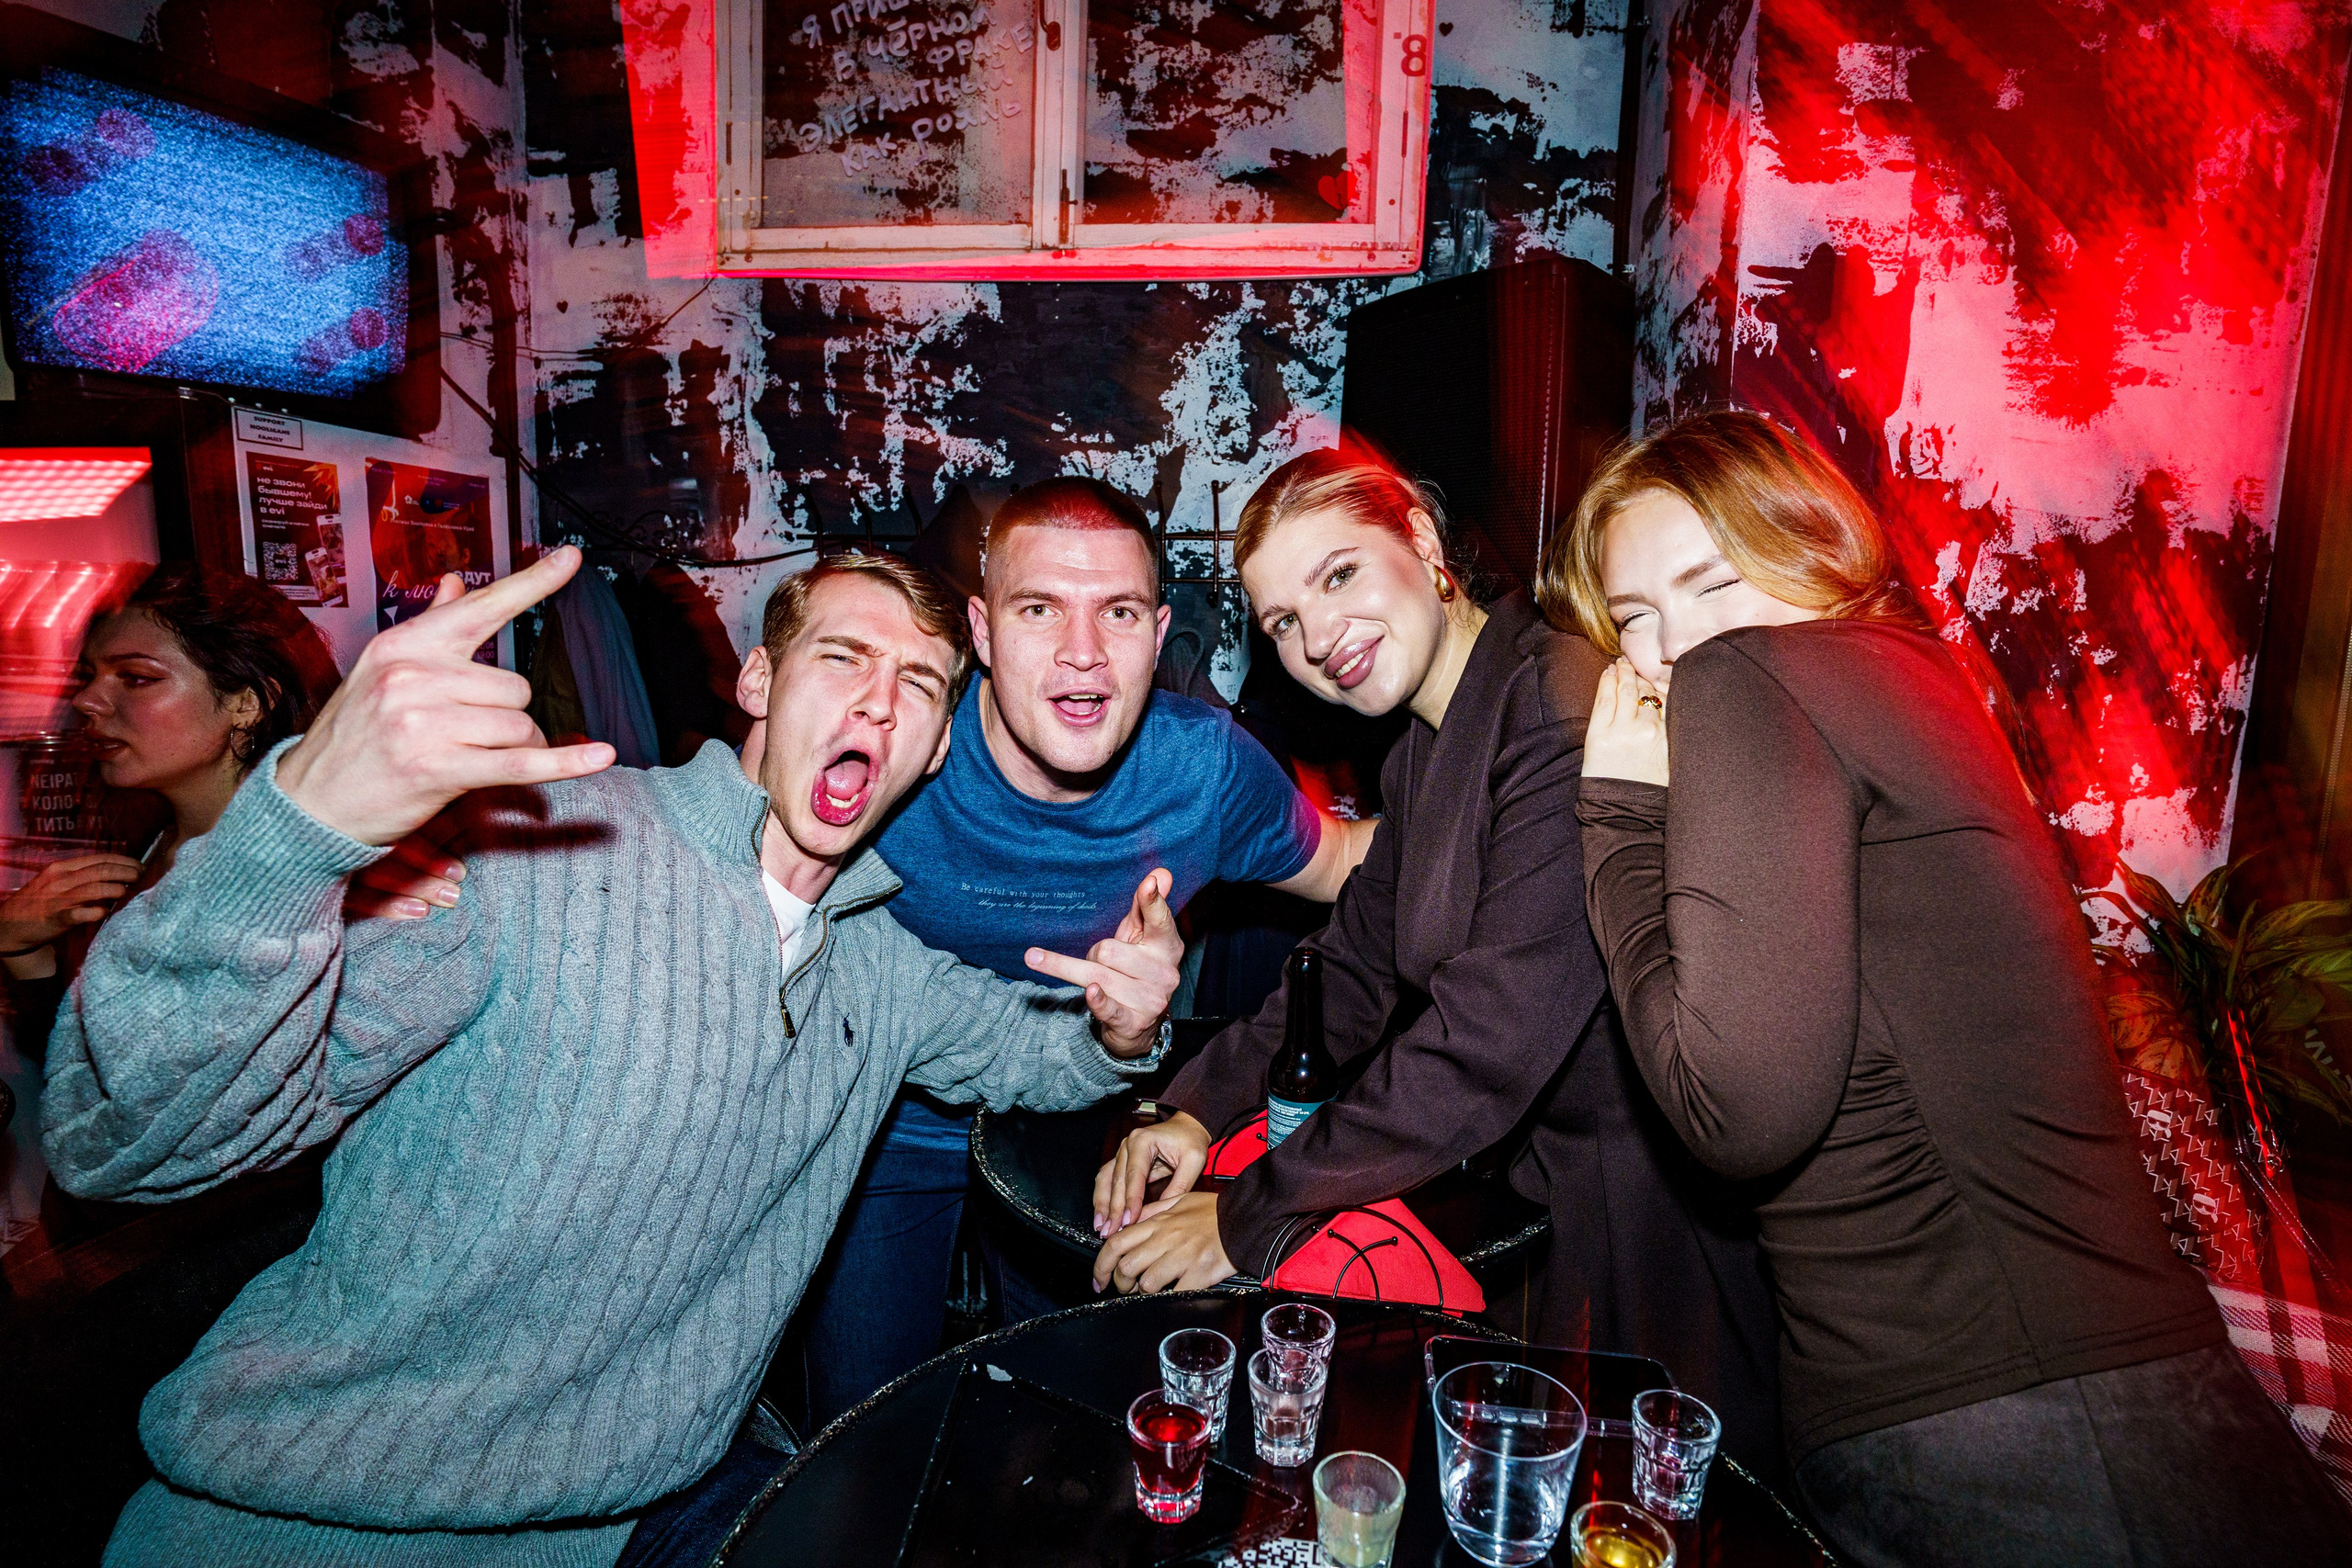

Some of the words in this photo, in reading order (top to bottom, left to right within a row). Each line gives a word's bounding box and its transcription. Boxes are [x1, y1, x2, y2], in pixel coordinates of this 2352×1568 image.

[802, 14, 823, 49] Я
[834, 51, 856, 82] В
[254, 416, 286, 425] SUPPORT
[250, 423, 290, 435] HOOLIGANS
[257, 434, 284, 442] FAMILY
[273, 479, 306, 489] звони
[257, 485, 312, 500] бывшему!
[259, 497, 294, 506] лучше
[296, 501, 328, 510] зайди
[961, 882, 971, 891] Be
[975, 886, 1005, 896] careful
[1053, 891, 1086, 899] thoughts
